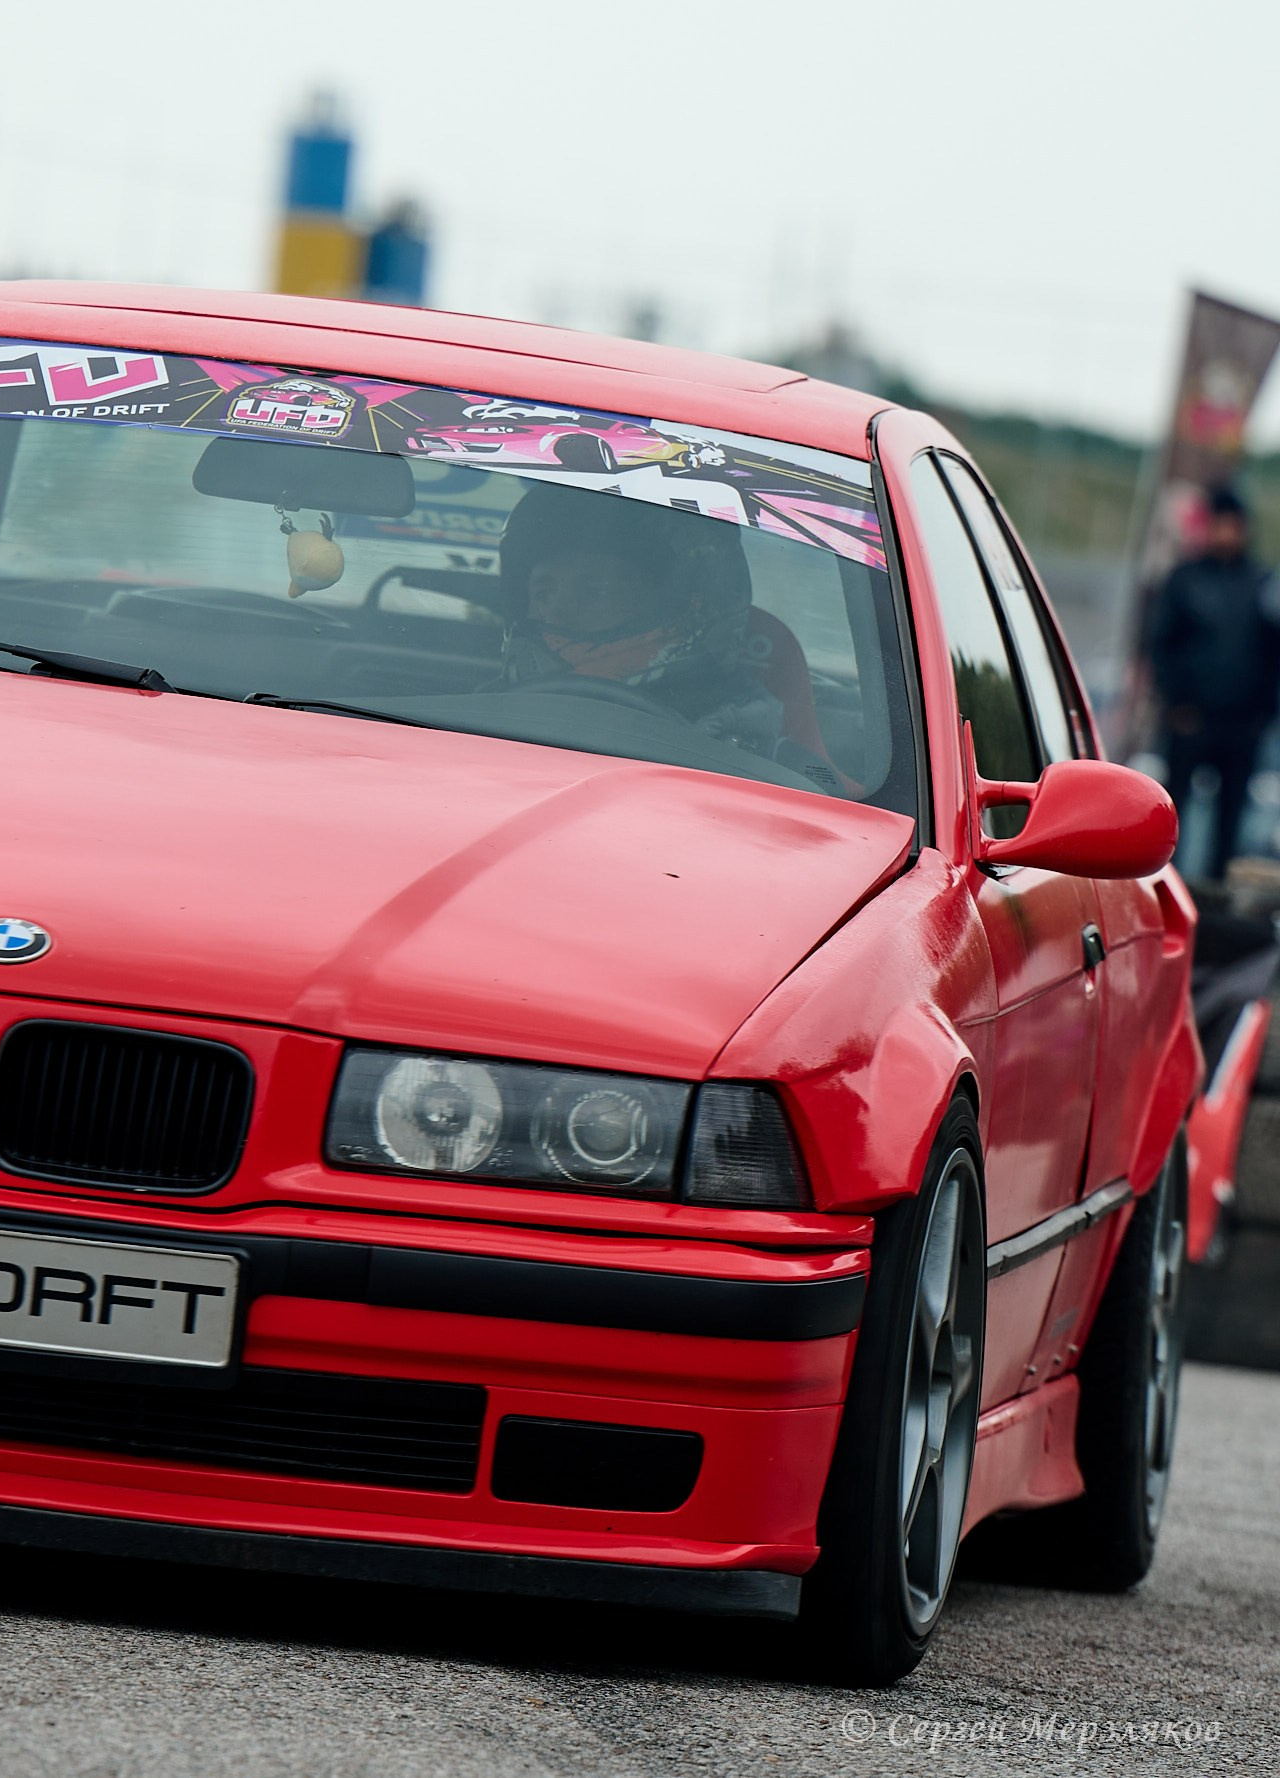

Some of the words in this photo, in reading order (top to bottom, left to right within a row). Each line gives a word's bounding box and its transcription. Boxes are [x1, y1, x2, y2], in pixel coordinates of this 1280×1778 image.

[52, 406, 88, 418] OF
[93, 403, 171, 416] DRIFT
[248, 420, 299, 431] FEDERATION
[311, 428, 338, 436] DRIFT
